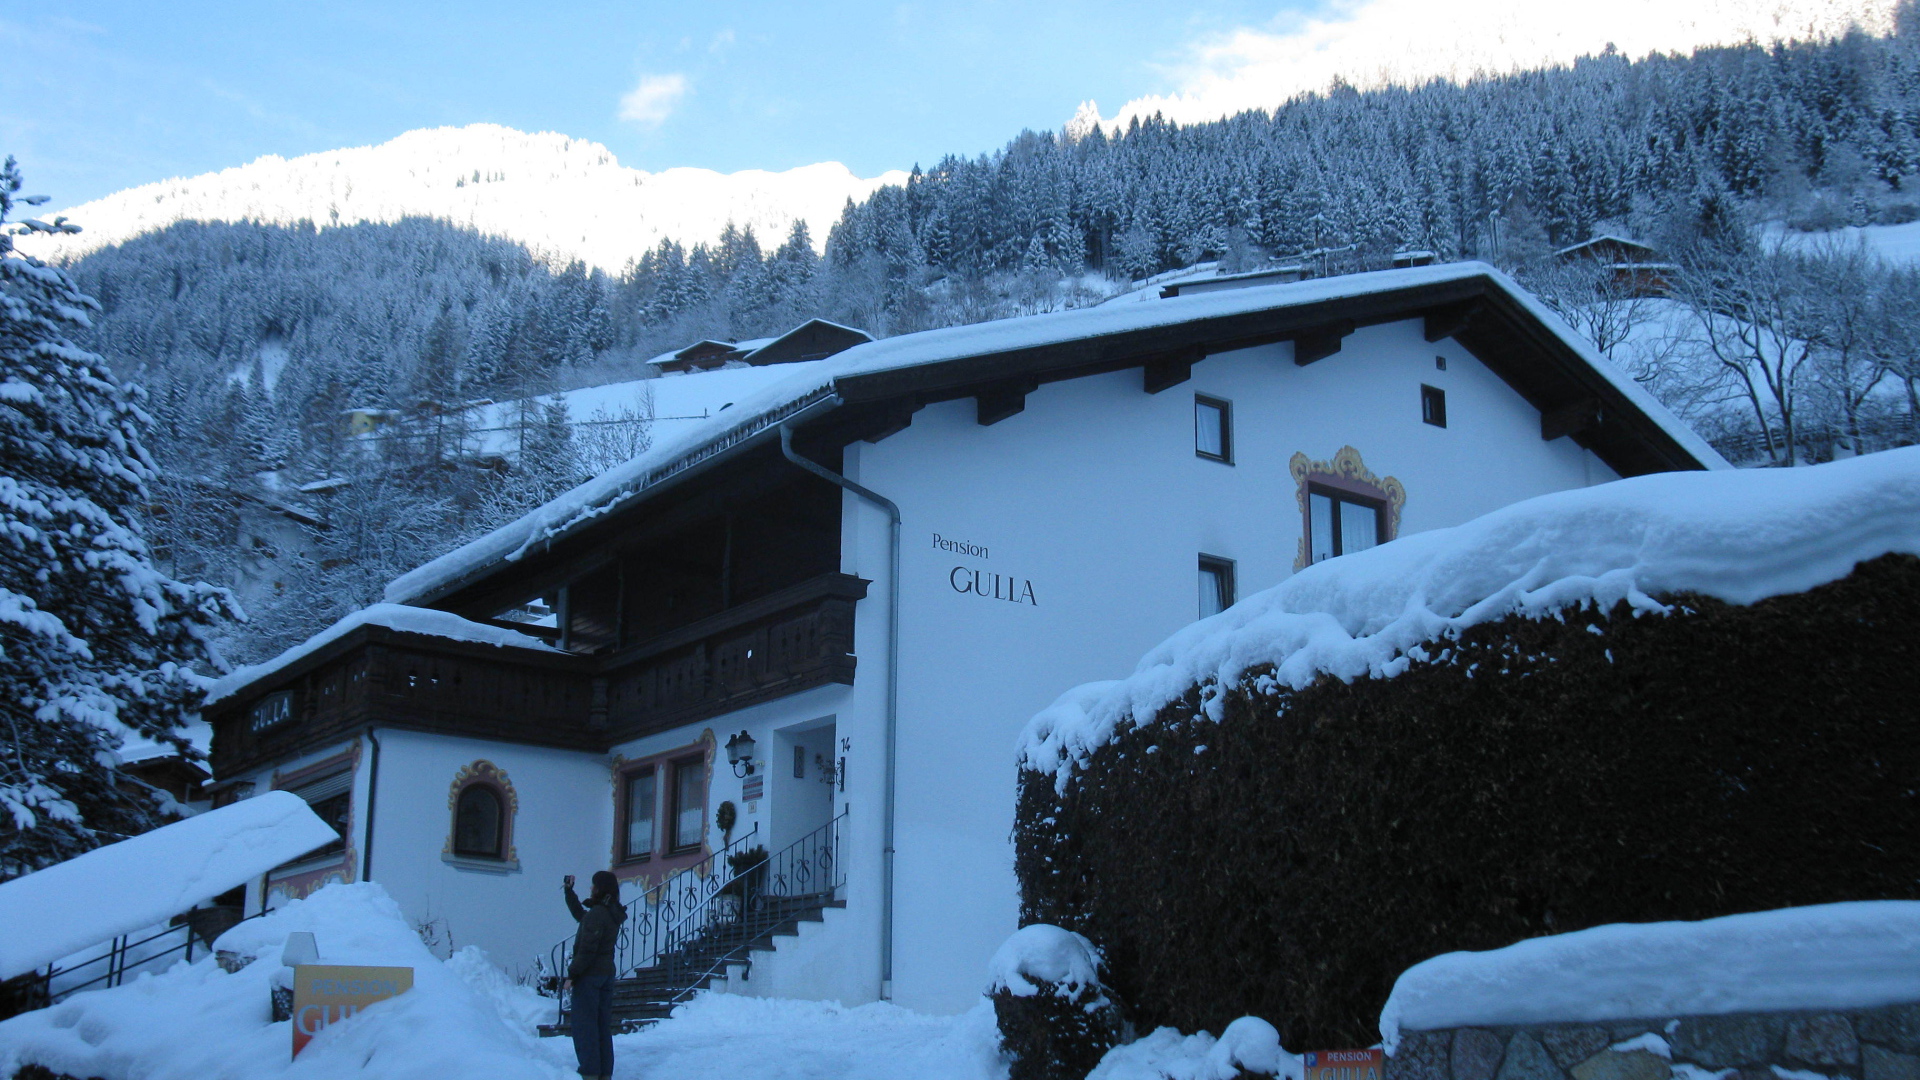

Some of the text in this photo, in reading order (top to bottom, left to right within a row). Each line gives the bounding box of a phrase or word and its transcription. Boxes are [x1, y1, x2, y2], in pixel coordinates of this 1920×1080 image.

[932, 533, 988, 559] Pension
[949, 566, 1038, 606] GULLA
[841, 736, 851, 753] 14
[311, 978, 398, 996] PENSION
[1327, 1051, 1372, 1062] PENSION
